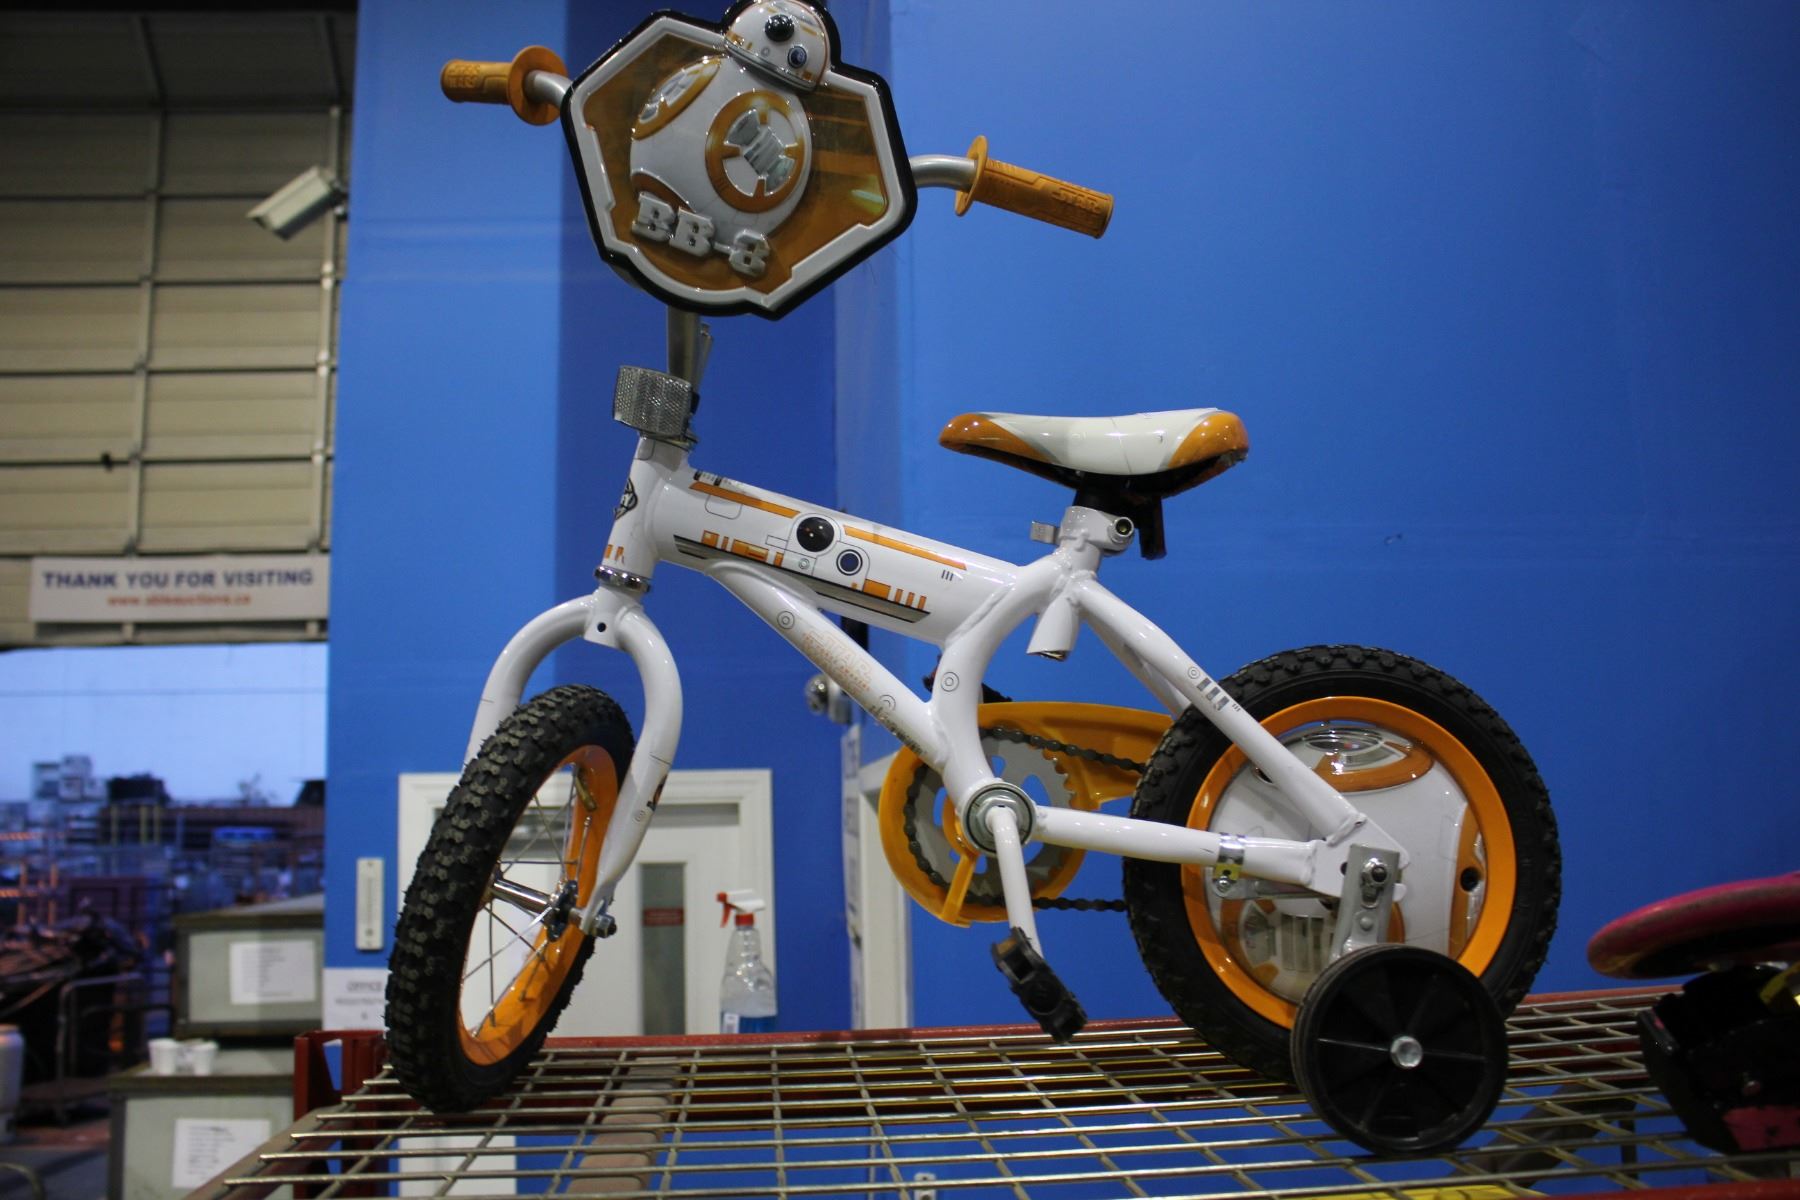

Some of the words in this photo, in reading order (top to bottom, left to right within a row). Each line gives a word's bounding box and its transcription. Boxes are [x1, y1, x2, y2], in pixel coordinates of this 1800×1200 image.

[631, 190, 771, 279] BB-8
[42, 571, 117, 589] THANK
[126, 571, 169, 589] YOU
[174, 571, 214, 588] FOR
[222, 567, 314, 588] VISITING
